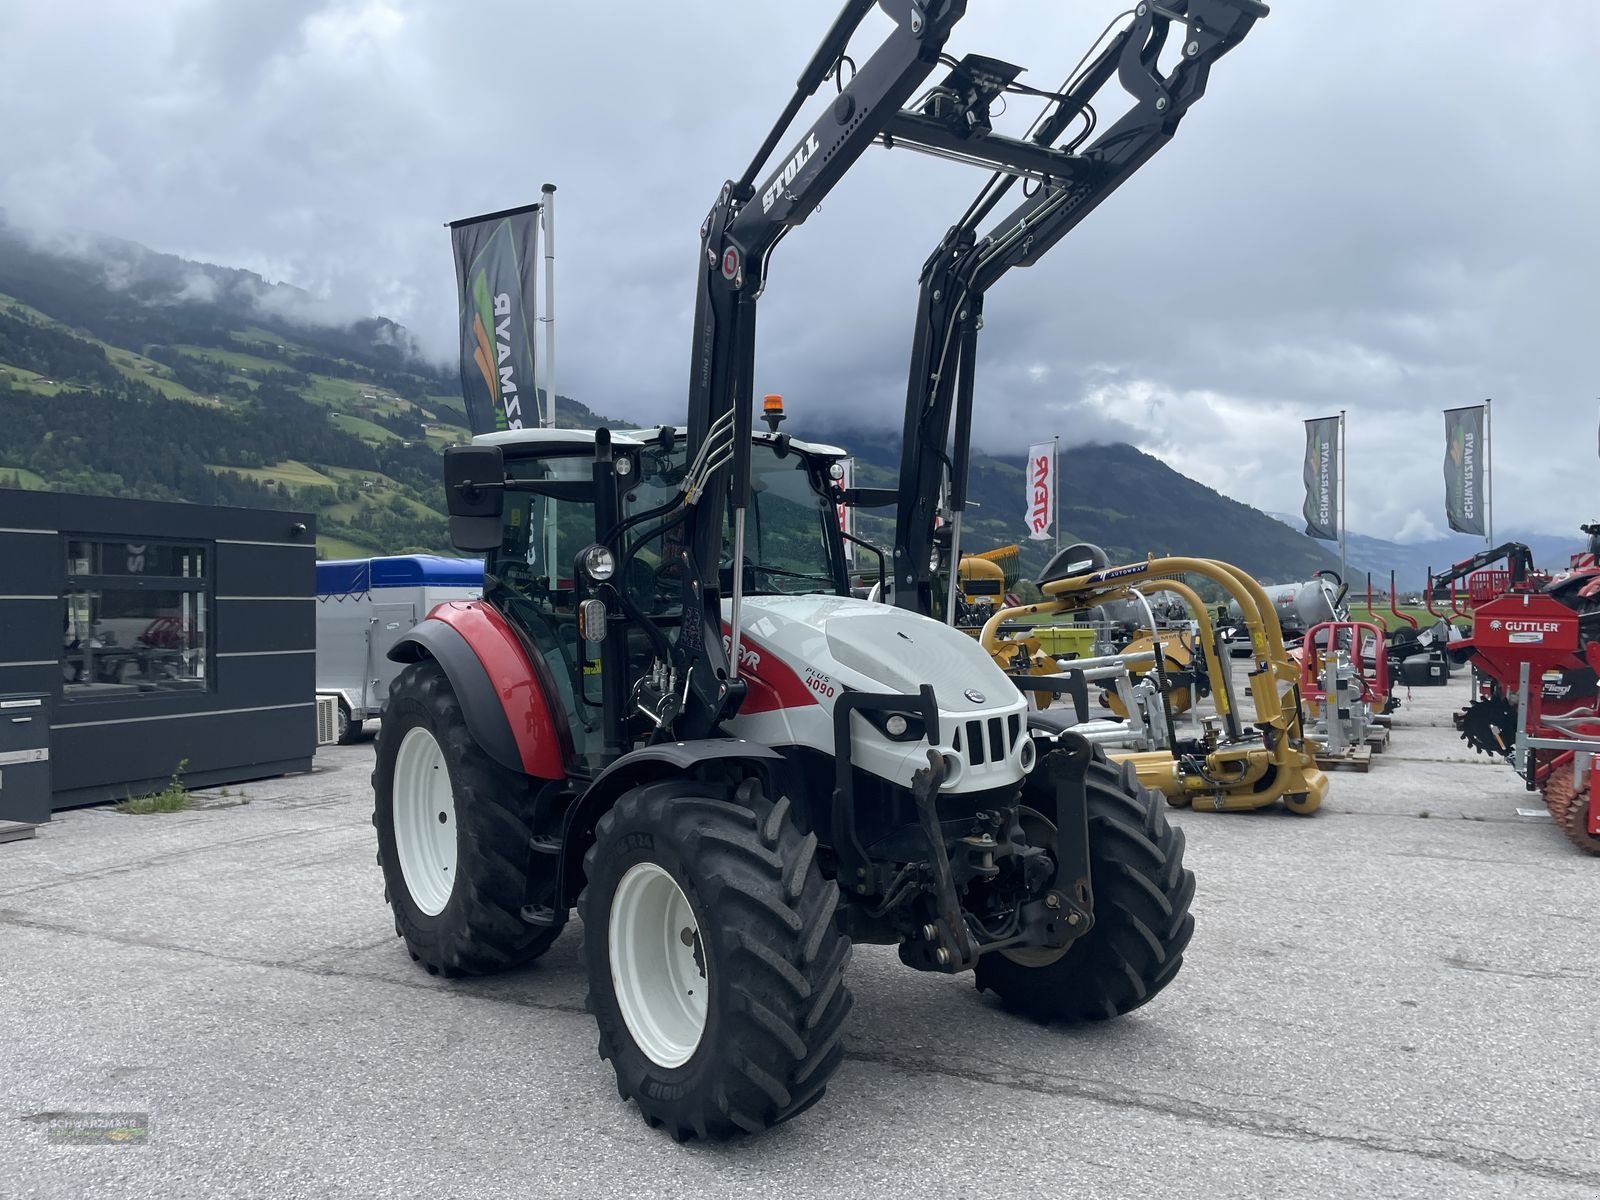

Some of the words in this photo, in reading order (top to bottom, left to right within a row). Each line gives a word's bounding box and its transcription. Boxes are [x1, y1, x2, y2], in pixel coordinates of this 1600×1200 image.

[762, 132, 819, 214] STOLL
[1111, 566, 1145, 577] AUTOWRAP
[805, 667, 831, 683] PLUS
[806, 675, 835, 698] 4090
[35, 749, 42, 760] 2
